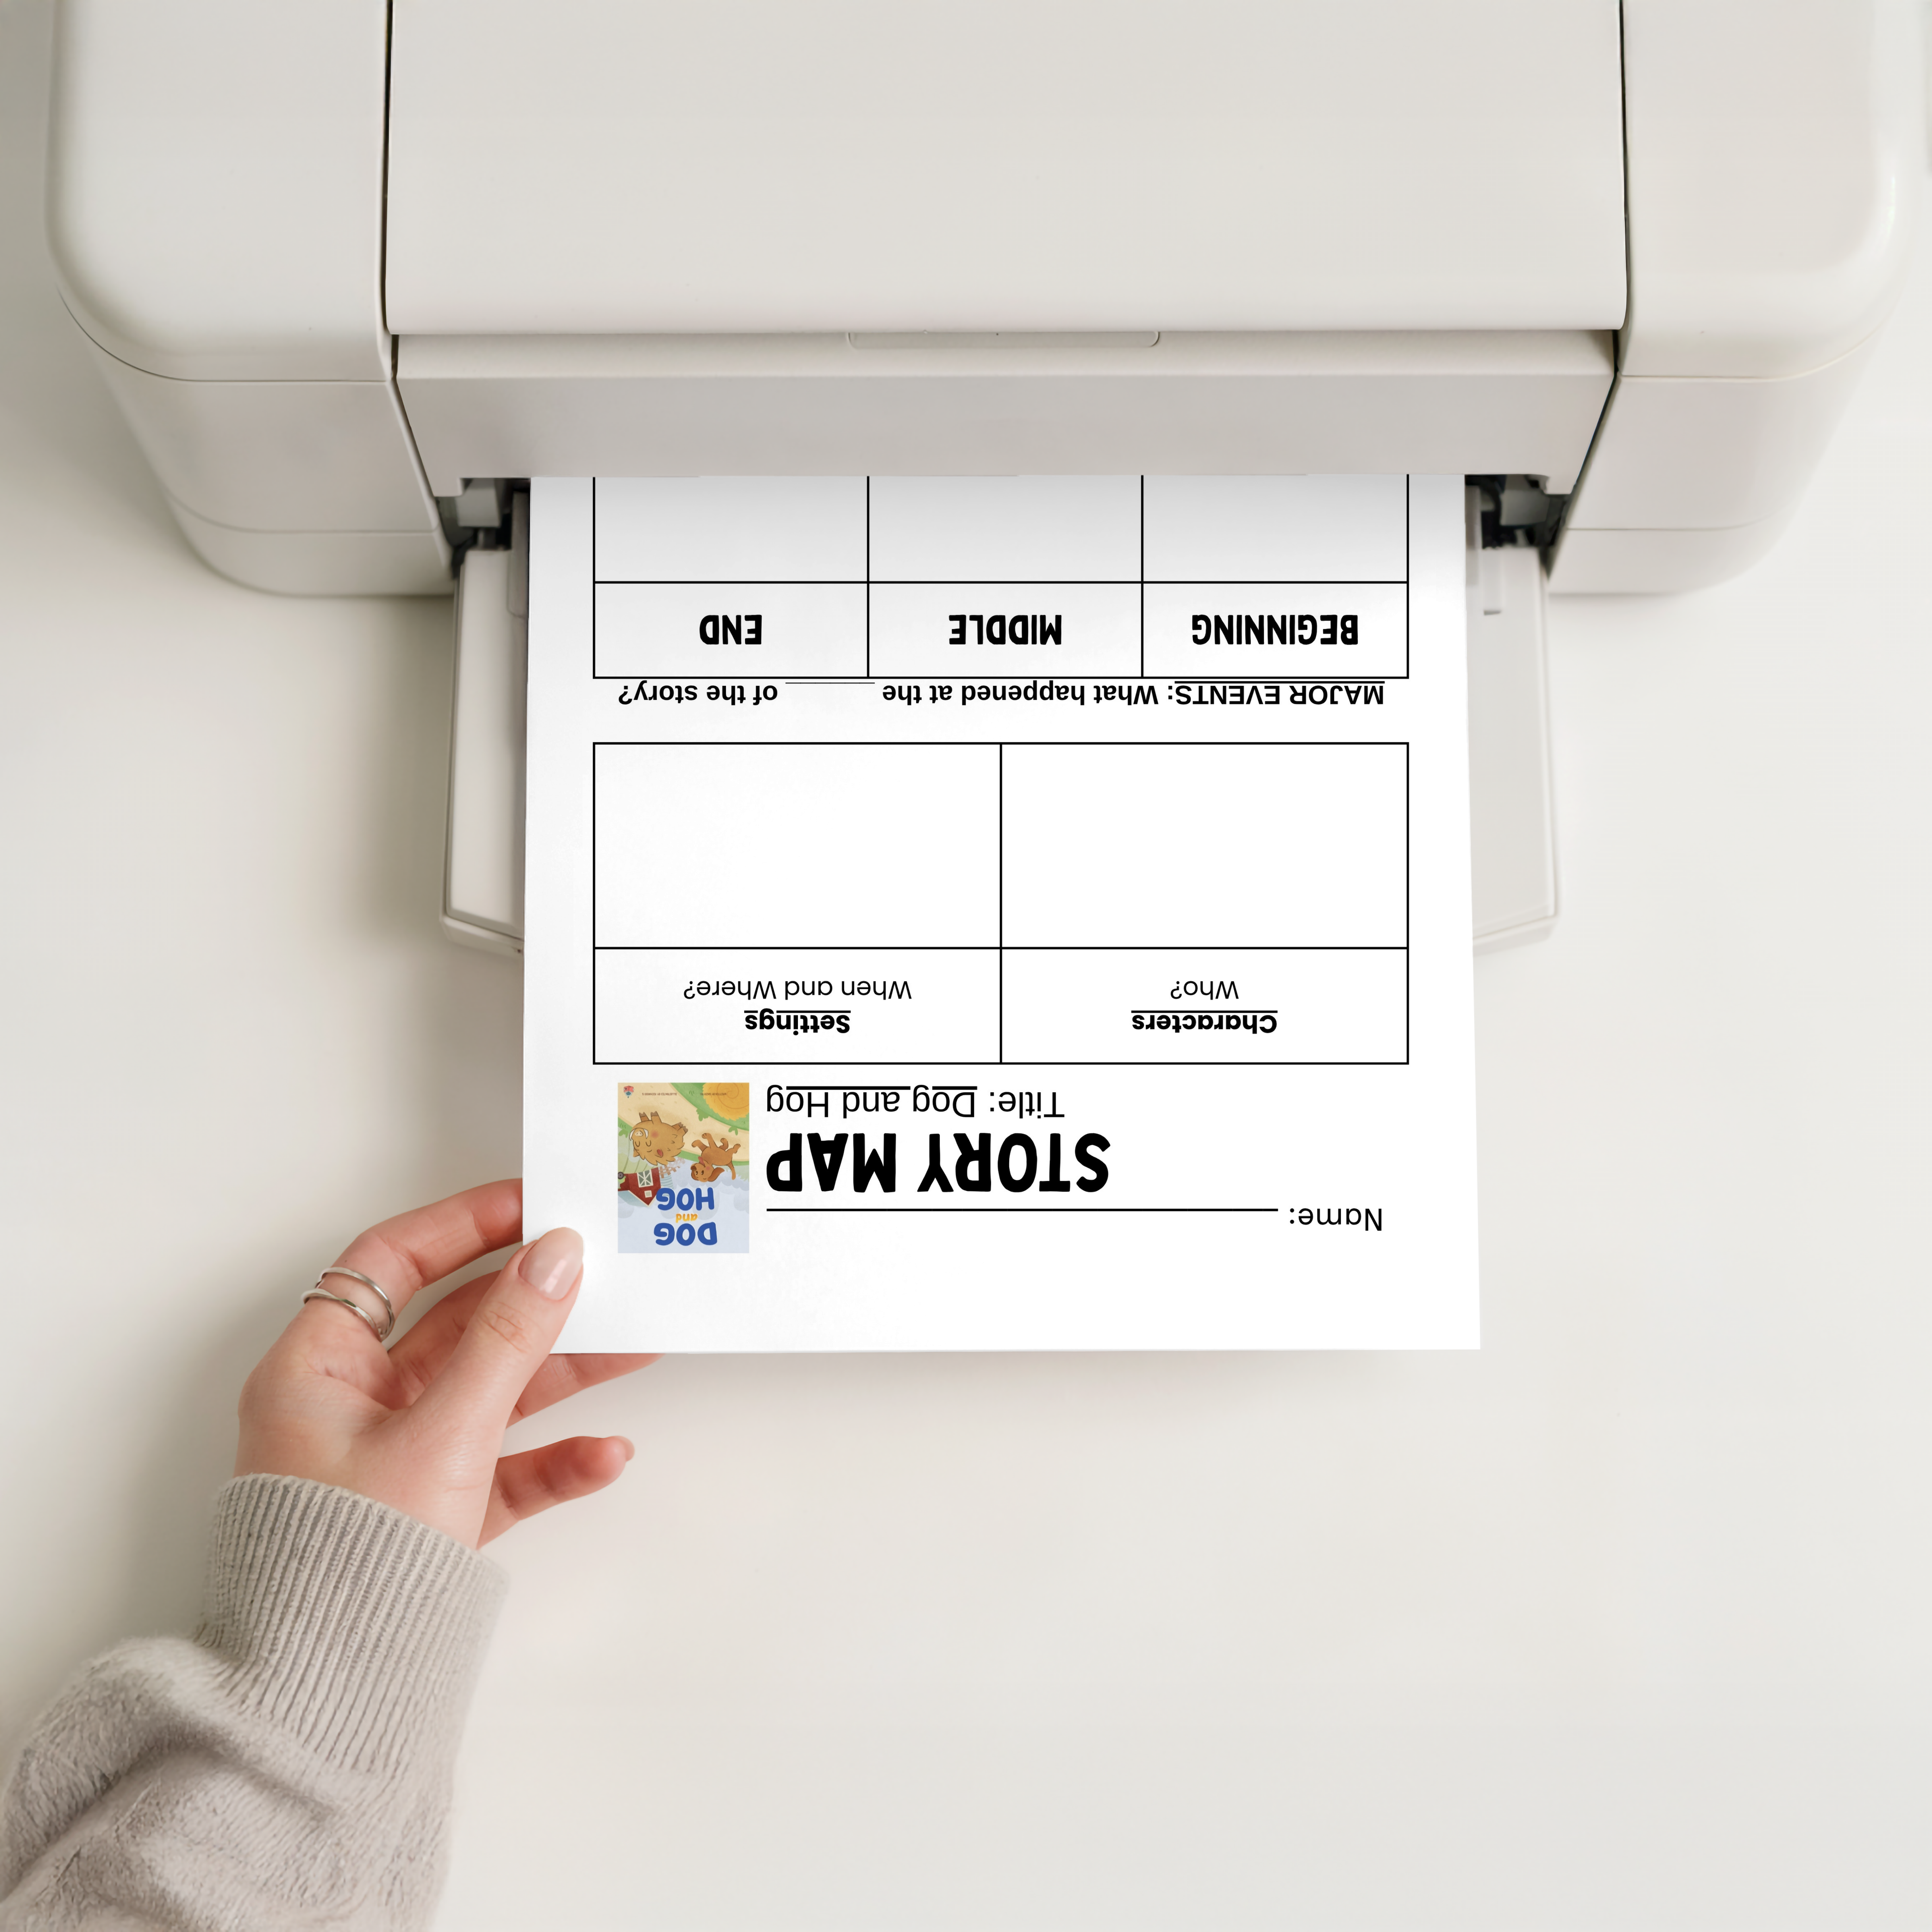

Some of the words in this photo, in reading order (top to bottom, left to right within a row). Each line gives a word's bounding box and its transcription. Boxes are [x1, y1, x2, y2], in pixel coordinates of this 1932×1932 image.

[699, 614, 762, 645] END
[948, 614, 1062, 645] MIDDLE
[1192, 614, 1358, 646] BEGINNING
[618, 680, 698, 705] story?
[706, 685, 746, 706] the
[753, 685, 778, 706] of
[882, 685, 922, 706] the
[929, 685, 952, 704] at
[961, 680, 1085, 706] happened
[1093, 685, 1159, 706] What
[1168, 681, 1280, 705] EVENTS:
[1289, 681, 1384, 705] MAJOR
[683, 981, 777, 1000] Where?
[785, 981, 833, 1000] and
[841, 981, 912, 1000] When
[1170, 981, 1239, 1000] Who?
[745, 1008, 851, 1036] Settings
[1132, 1010, 1277, 1034] Characters
[767, 1084, 829, 1118] Hog
[843, 1086, 900, 1119] and
[913, 1084, 975, 1118] Dog
[990, 1091, 1065, 1119] Title:
[766, 1133, 897, 1193] MAP
[917, 1133, 1111, 1193] STORY
[656, 1187, 714, 1211] HOG
[675, 1213, 698, 1223] and
[1290, 1208, 1382, 1231] Name:
[654, 1222, 717, 1246] DOG
